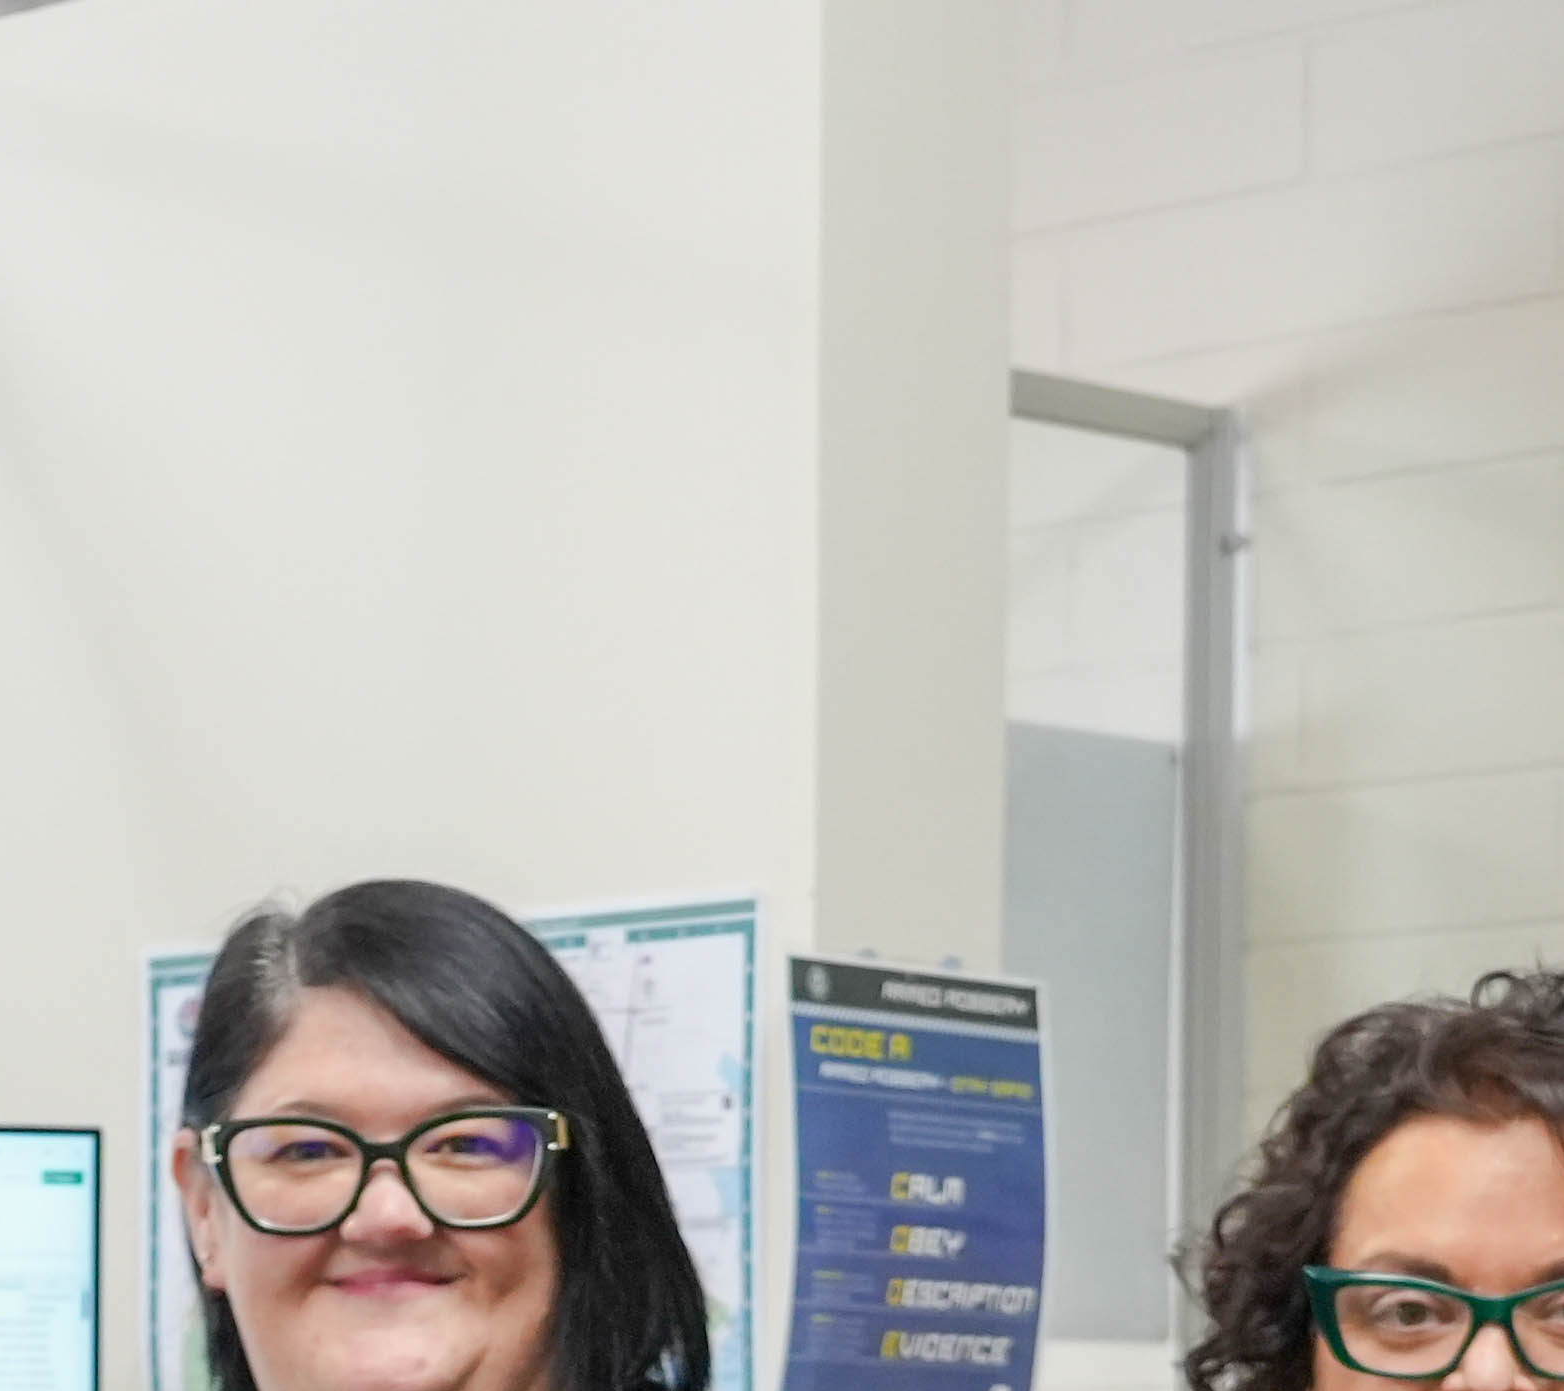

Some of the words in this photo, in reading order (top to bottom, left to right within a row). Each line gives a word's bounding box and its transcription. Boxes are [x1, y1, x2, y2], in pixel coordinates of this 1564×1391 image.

[811, 1023, 886, 1061] CODE
[891, 1171, 965, 1206] CALM
[886, 1277, 1037, 1315] DESCRIPTION
[879, 1330, 1012, 1366] EVIDENCE
